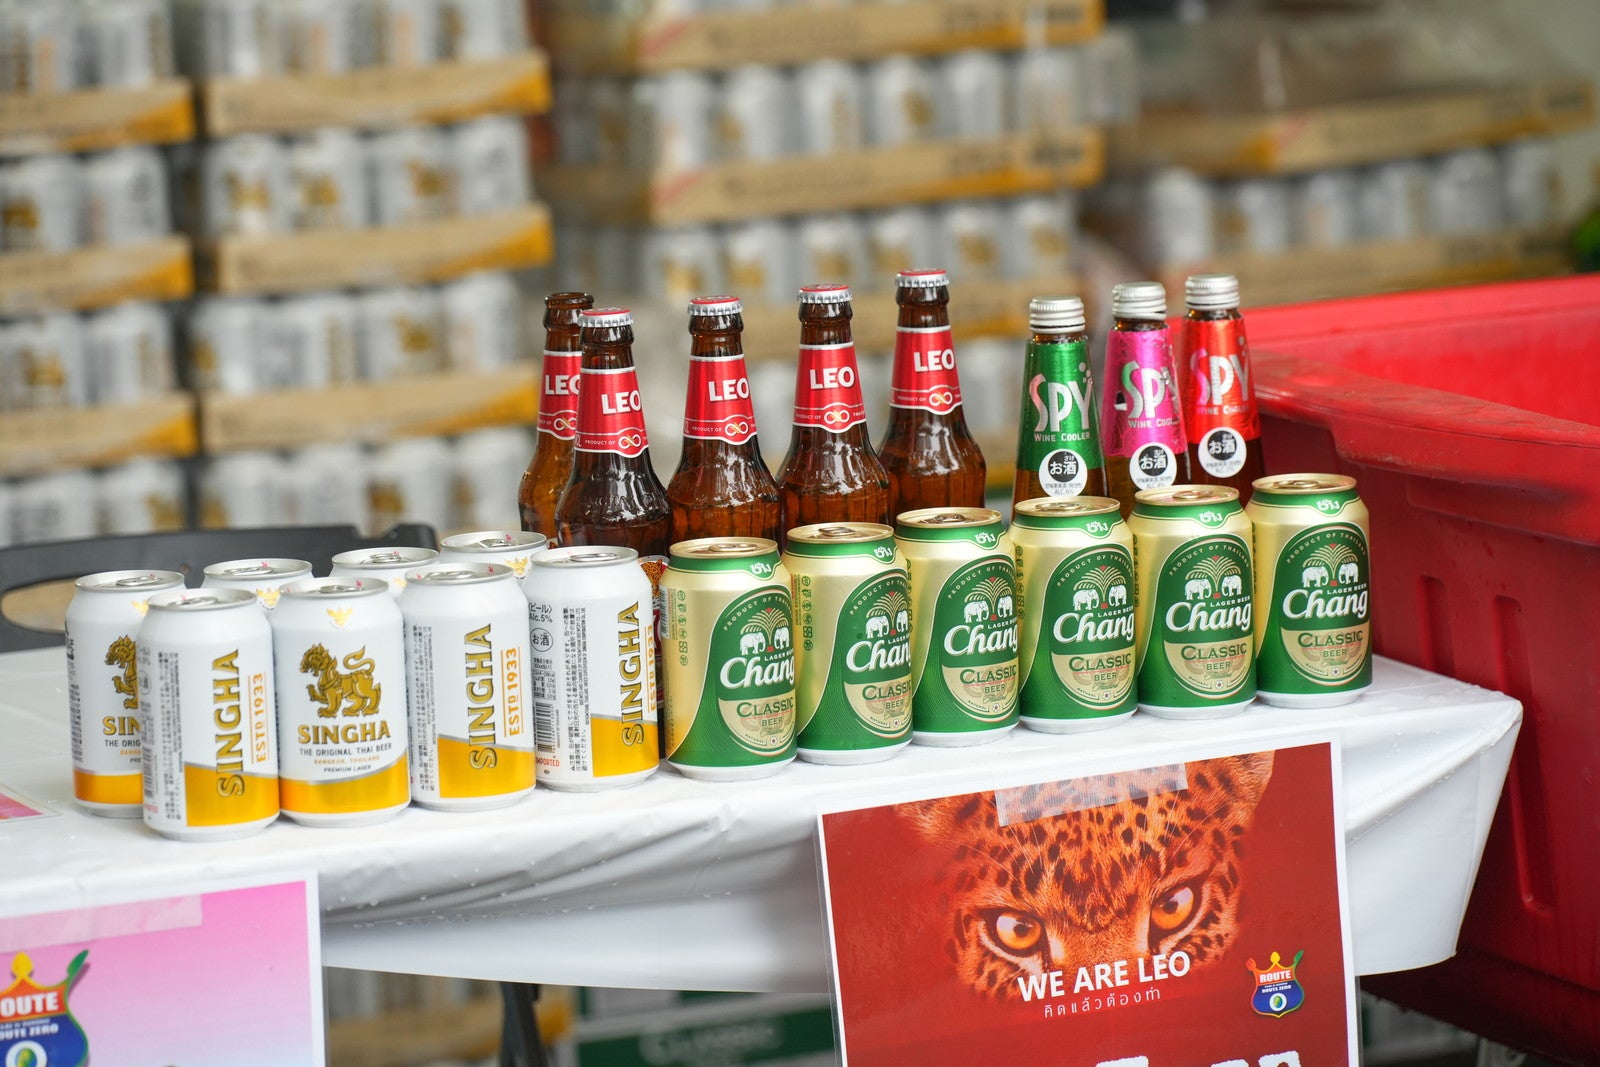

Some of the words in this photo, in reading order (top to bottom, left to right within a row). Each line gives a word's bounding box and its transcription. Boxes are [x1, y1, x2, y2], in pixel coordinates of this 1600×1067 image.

[914, 348, 954, 372] LEO
[809, 366, 854, 390] LEO
[1190, 347, 1249, 406] SPY
[708, 377, 750, 402] LEO
[1121, 360, 1180, 418] SPY
[600, 390, 641, 415] LEO
[1029, 373, 1094, 432] SPY
[1128, 420, 1152, 428] WINE
[1034, 433, 1056, 442] WINE
[1061, 432, 1090, 442] COOLER
[1208, 440, 1236, 454] お酒
[1050, 461, 1076, 475] お酒
[1140, 455, 1166, 470] お酒
[1168, 548, 1204, 576] PRODUCT
[1286, 536, 1322, 564] PRODUCT
[1056, 558, 1092, 587] PRODUCT
[948, 570, 982, 600] PRODUCT
[1327, 586, 1353, 596] LAGER
[850, 584, 882, 616] PRODUCT
[1210, 599, 1236, 608] LAGER
[1282, 588, 1368, 620] Chang
[723, 600, 758, 632] PRODUCT
[988, 620, 1009, 629] LAGER
[1098, 609, 1122, 618] LAGER
[1165, 601, 1252, 632] Chang
[532, 632, 550, 646] お酒
[1052, 612, 1134, 644] Chang
[1298, 630, 1364, 648] CLASSIC
[764, 652, 786, 662] LAGER
[846, 639, 912, 673] Chan
[1068, 653, 1132, 672] CLASSIC
[1180, 642, 1248, 661] CLASSIC
[1322, 649, 1348, 658] BEER
[506, 648, 518, 690] 1933
[618, 601, 644, 746] SINGHA
[719, 656, 795, 690] Chang
[1094, 672, 1117, 682] BEER
[1206, 661, 1232, 670] BEER
[252, 672, 265, 718] 1933
[464, 623, 498, 770] SINGHA
[984, 684, 1006, 694] BEER
[212, 649, 246, 798] SINGHA
[508, 694, 520, 736] ESTD
[761, 716, 783, 727] BEER
[104, 739, 119, 747] THE
[122, 738, 142, 747] ORIG
[255, 722, 267, 763] ESTD
[298, 720, 392, 745] SINGHA
[316, 748, 352, 756] ORIGINAL
[356, 746, 374, 754] THAI
[376, 742, 392, 752] BEER
[1018, 970, 1066, 1002] WE
[1073, 960, 1130, 994] ARE
[1138, 950, 1191, 983] LEO
[1259, 970, 1292, 984] ROUTE
[29, 1022, 59, 1036] ZERO
